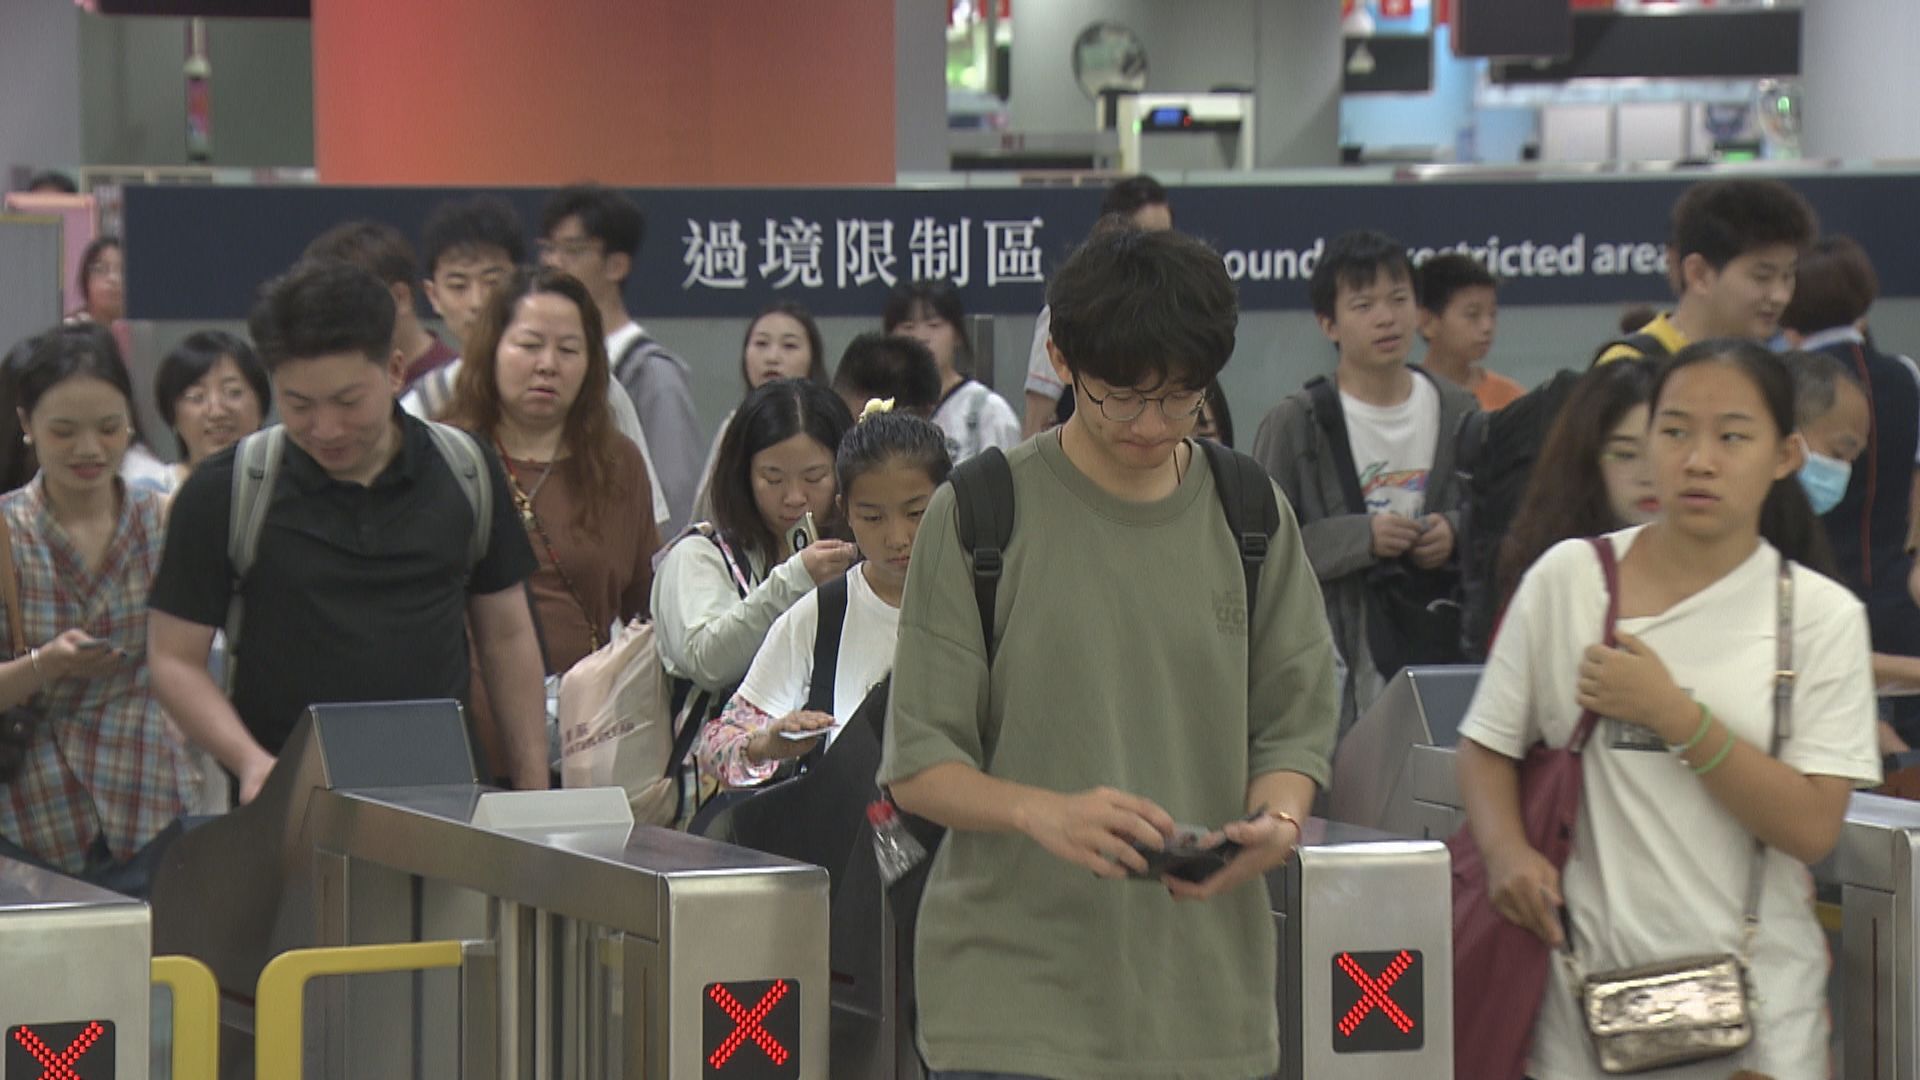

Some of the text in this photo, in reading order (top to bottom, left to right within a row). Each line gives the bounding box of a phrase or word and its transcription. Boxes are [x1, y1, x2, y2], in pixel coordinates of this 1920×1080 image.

[682, 216, 1045, 289] 過境限制區
